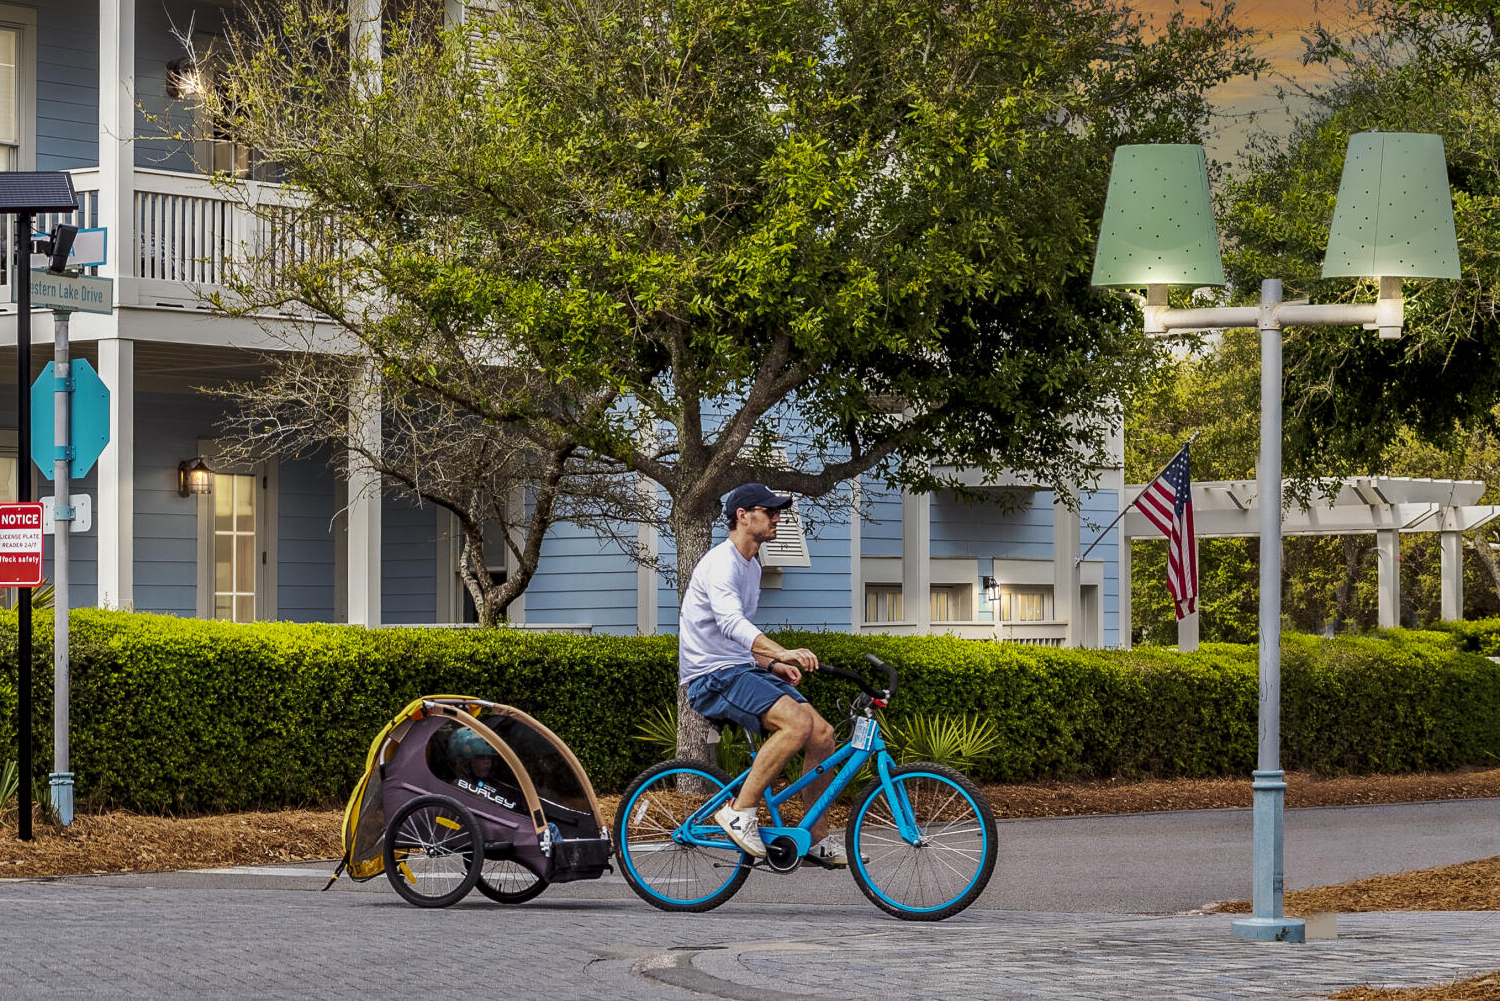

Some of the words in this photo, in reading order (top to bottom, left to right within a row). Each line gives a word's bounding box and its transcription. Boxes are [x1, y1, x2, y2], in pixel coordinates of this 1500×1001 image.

[30, 280, 56, 298] estern
[58, 282, 79, 300] Lake
[81, 285, 103, 303] Drive
[1, 514, 39, 525] NOTICE
[18, 555, 39, 565] safety
[457, 779, 516, 809] BURLEY
